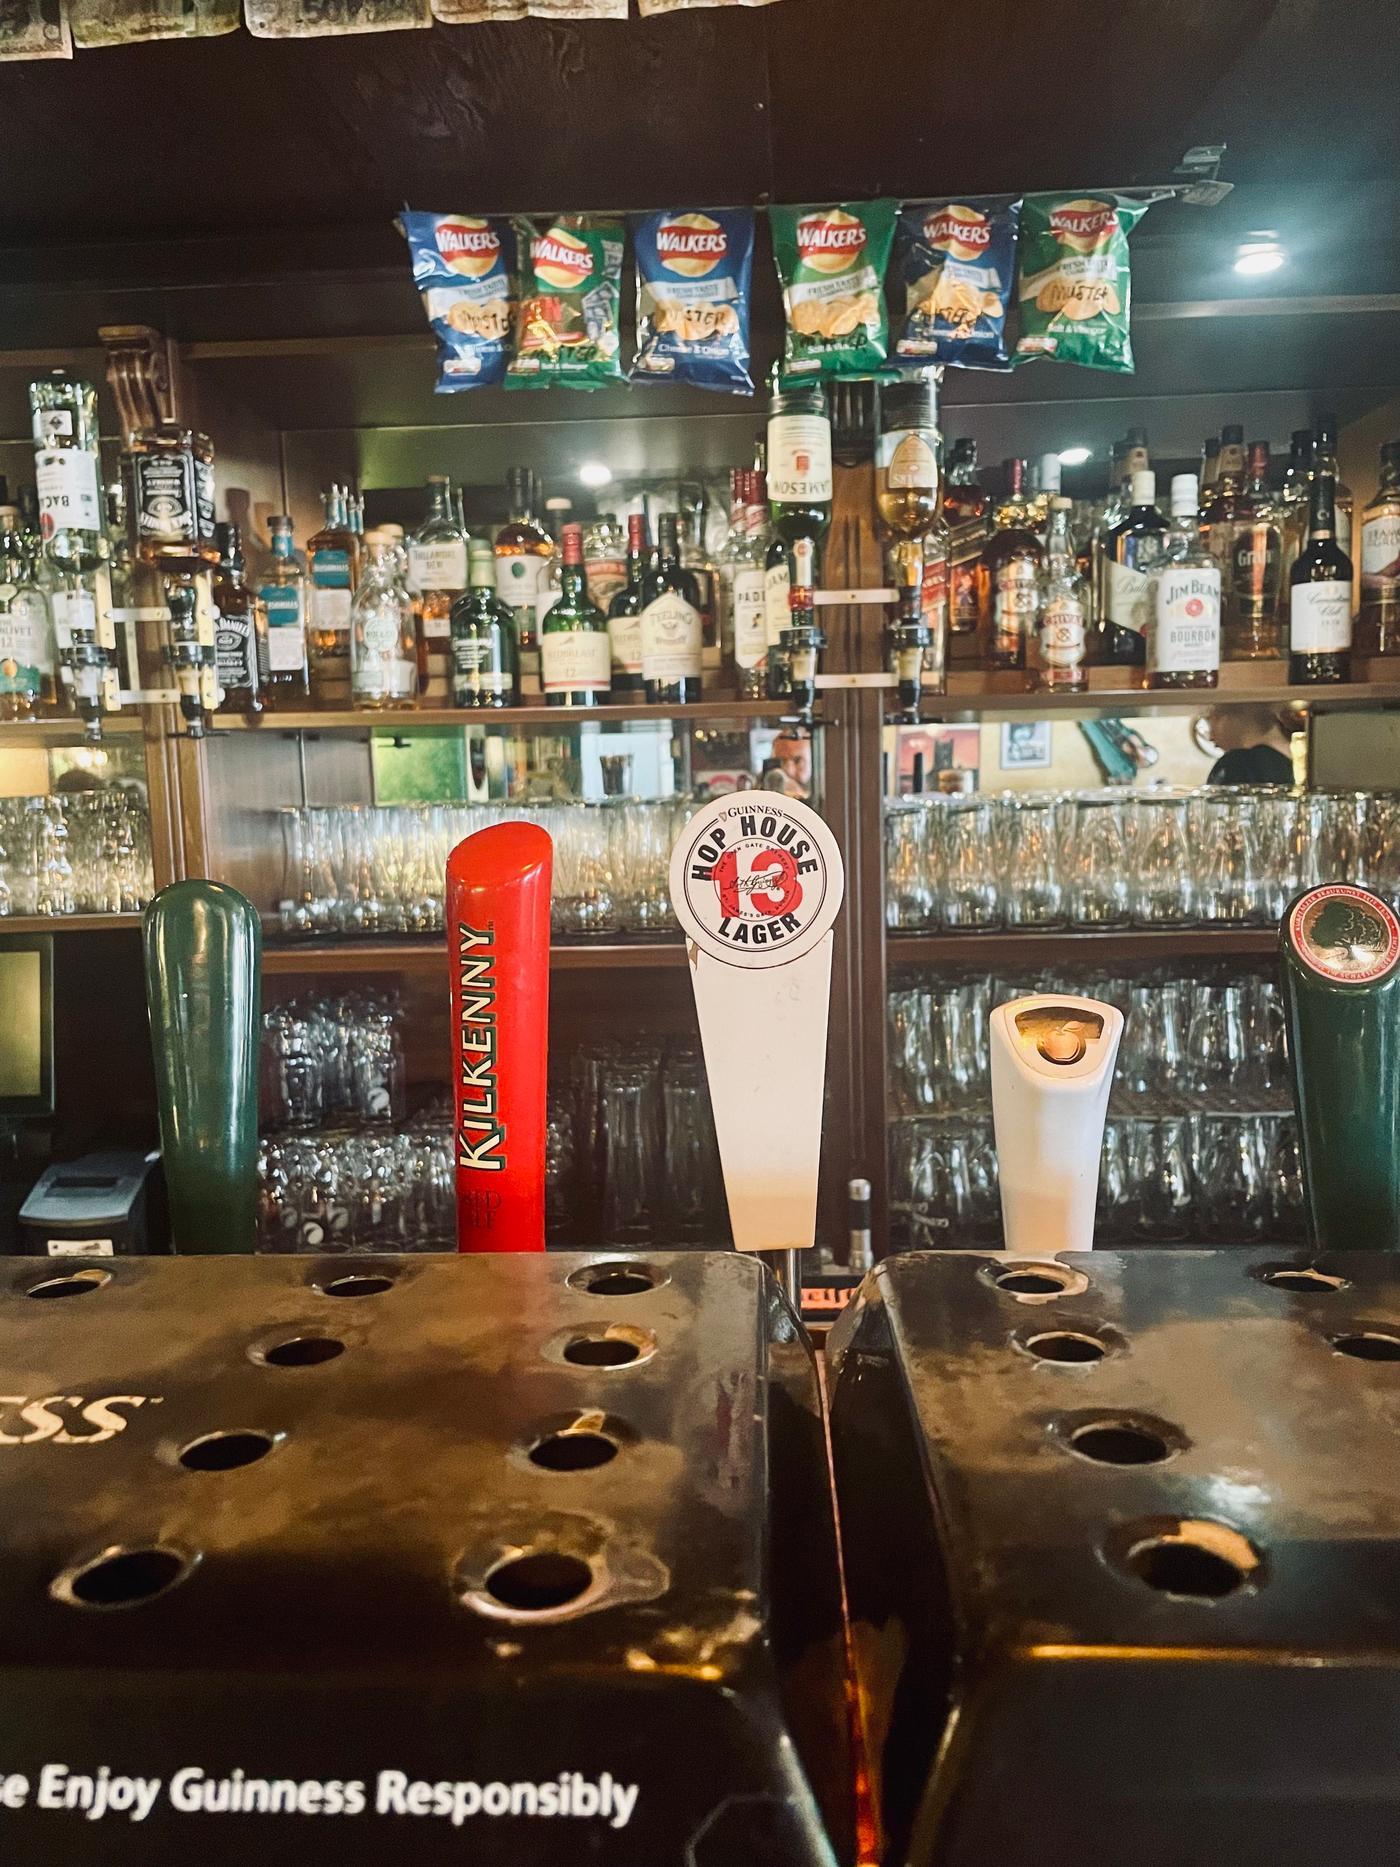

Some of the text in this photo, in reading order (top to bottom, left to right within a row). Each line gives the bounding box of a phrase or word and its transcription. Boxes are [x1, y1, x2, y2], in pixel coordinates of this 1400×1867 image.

[923, 220, 991, 244] WALKERS
[1051, 207, 1117, 233] WALKERS
[434, 227, 500, 252] WALKERS
[656, 229, 727, 252] WALKERS
[796, 225, 866, 249] WALKERS
[530, 240, 593, 269] WALKERS
[773, 479, 830, 496] JAMESON
[1165, 584, 1188, 606] JIM
[1169, 629, 1216, 644] BOURBON
[727, 804, 784, 819] GUINNESS
[691, 814, 819, 882] HOP HOUSE
[744, 842, 763, 850] GATE
[710, 848, 804, 919] 13
[717, 911, 802, 945] LAGER
[458, 921, 506, 1172] KILKENNY
[37, 1763, 161, 1821] Enjoy
[168, 1766, 366, 1814] Guinness
[375, 1768, 639, 1828] Responsibly
